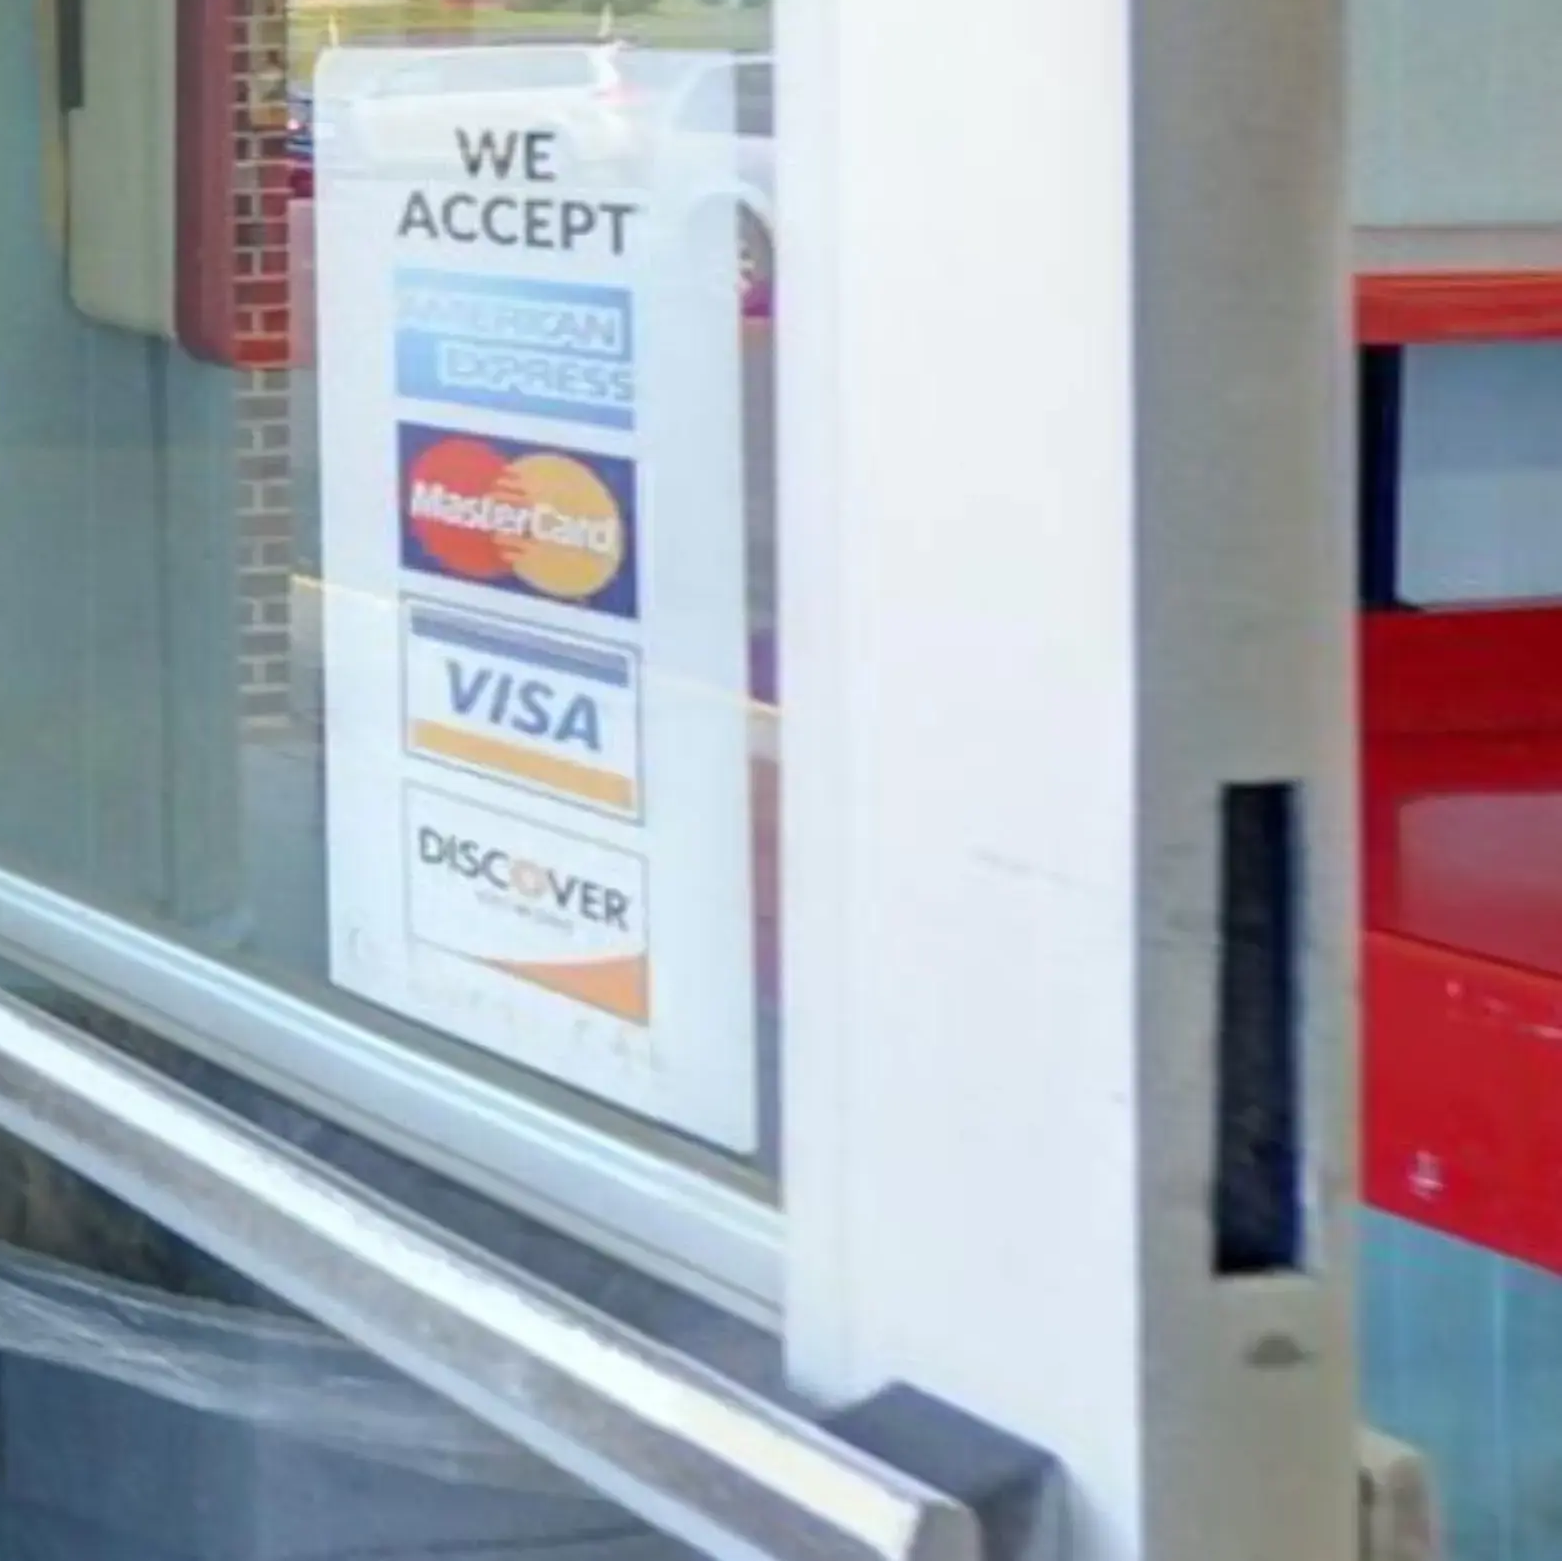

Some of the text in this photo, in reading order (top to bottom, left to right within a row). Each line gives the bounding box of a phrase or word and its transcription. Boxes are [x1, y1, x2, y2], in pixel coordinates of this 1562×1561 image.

[454, 127, 557, 183] WE
[397, 189, 639, 257] ACCEPT
[409, 480, 614, 556] MasterCard
[445, 659, 603, 752] VISA
[418, 826, 629, 931] DISCOVER
